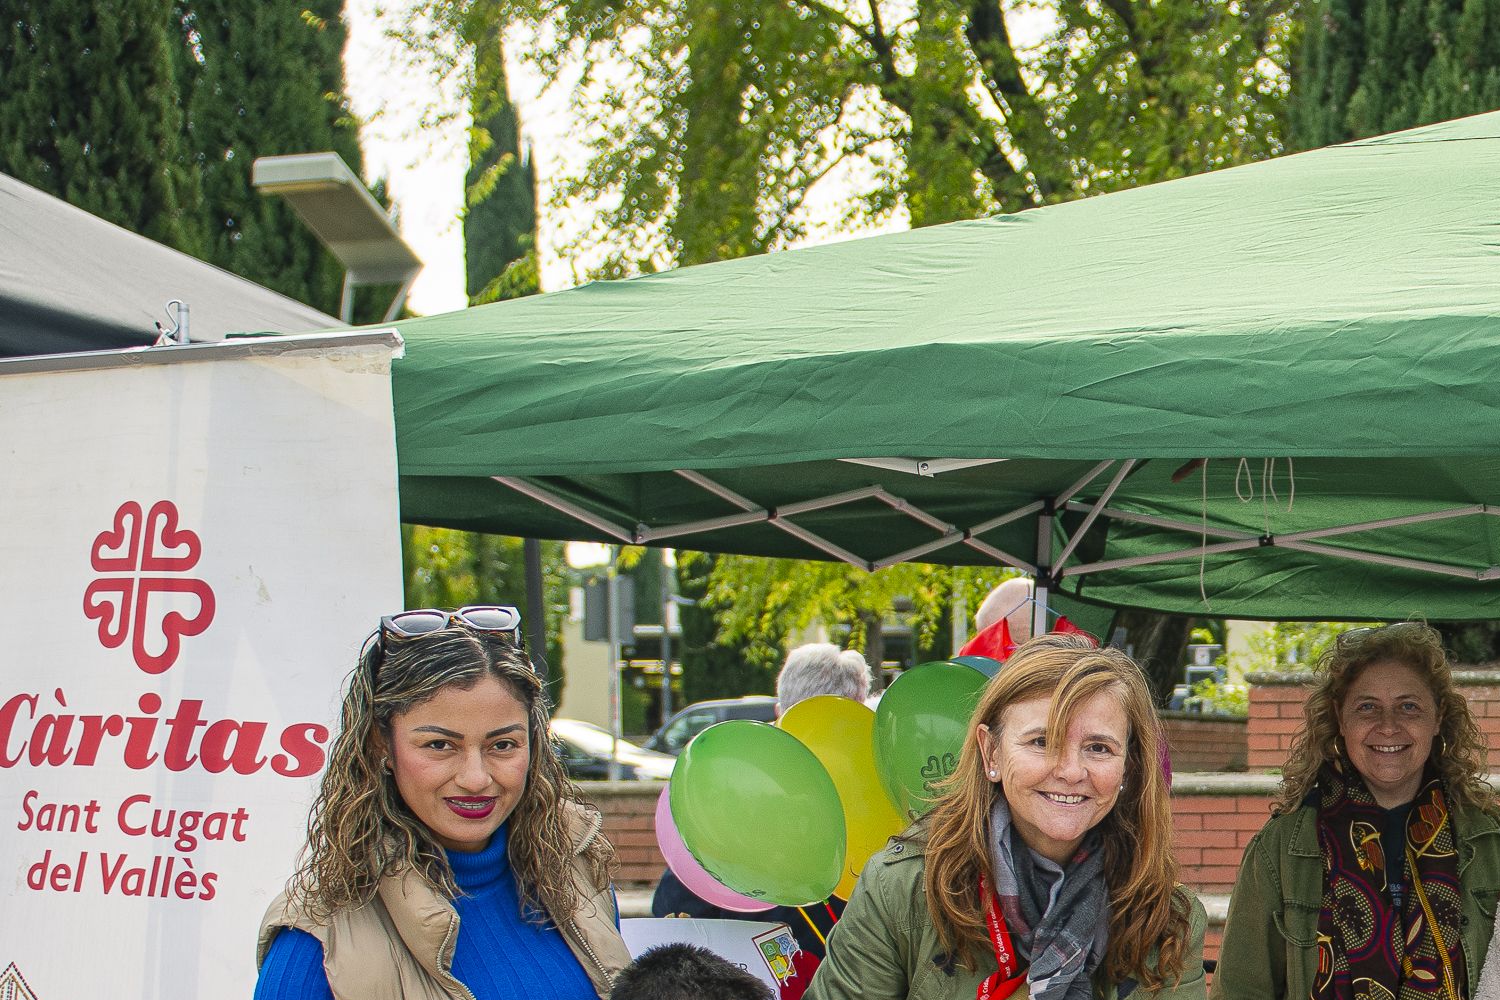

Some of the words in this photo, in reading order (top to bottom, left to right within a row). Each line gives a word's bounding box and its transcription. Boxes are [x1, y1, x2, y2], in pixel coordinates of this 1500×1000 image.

[0, 688, 329, 777] Càritas
[17, 790, 101, 833] Sant
[117, 794, 249, 852] Cugat
[26, 850, 88, 892] del
[100, 853, 218, 900] Vallès
